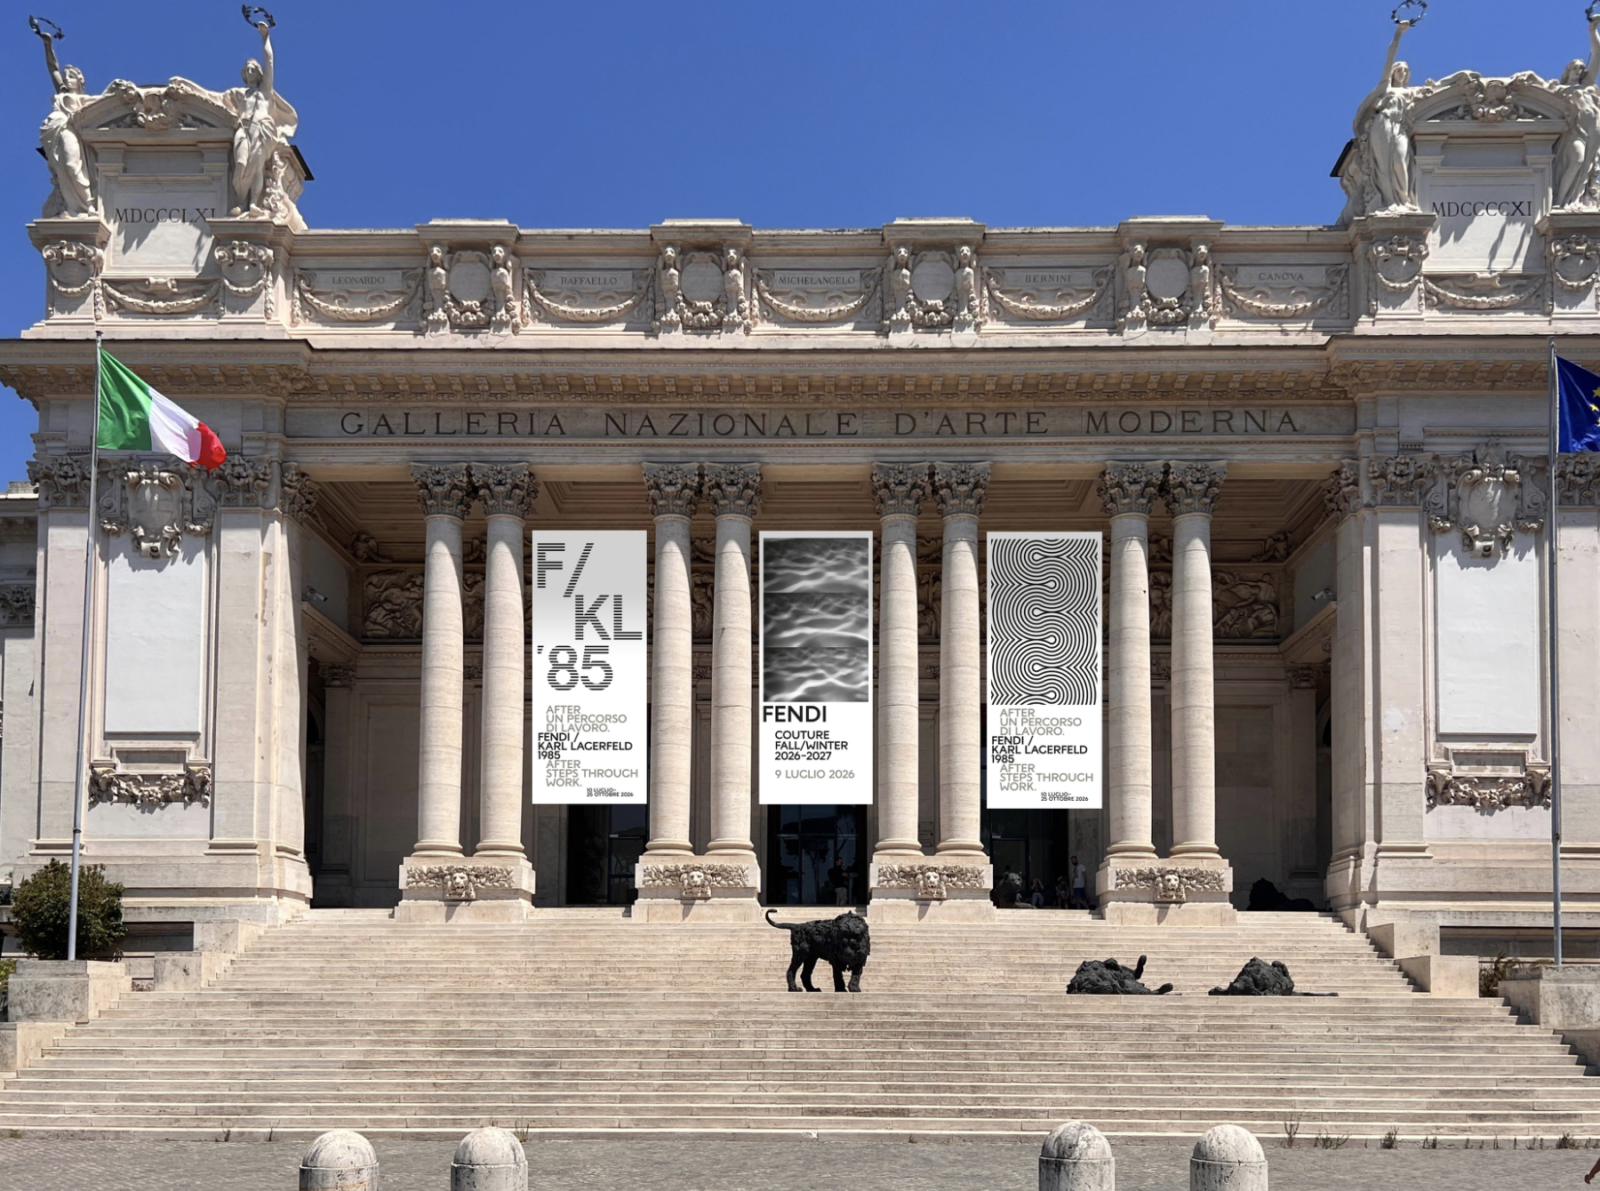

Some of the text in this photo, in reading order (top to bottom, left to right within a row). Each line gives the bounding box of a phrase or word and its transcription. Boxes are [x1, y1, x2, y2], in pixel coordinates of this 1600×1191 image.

[1432, 201, 1533, 217] MDCCCCXI
[332, 276, 385, 285] LEONARDO
[561, 276, 617, 285] RAFFAELLO
[779, 276, 856, 285] MICHELANGELO
[1025, 274, 1071, 283] BERNINI
[1258, 272, 1304, 281] CANOVA
[340, 410, 1300, 436] GALLERIA NAZIONALE D'ARTE MODERNA
[537, 543, 594, 597] F/
[575, 595, 642, 640] KL
[546, 705, 581, 714] AFTER
[763, 705, 826, 722] FENDI
[1000, 708, 1035, 717] AFTER
[546, 714, 627, 723] UN PERCORSO
[1000, 717, 1082, 727] UN PERCORSO
[546, 723, 610, 732] DI LAVORO.
[1000, 726, 1065, 735] DI LAVORO.
[538, 732, 570, 741] FENDI
[775, 730, 830, 739] COUTURE
[991, 736, 1024, 745] FENDI
[538, 741, 633, 750] KARL LAGERFELD
[775, 740, 848, 751] FALL/WINTER
[991, 745, 1088, 754] KARL LAGERFELD
[537, 750, 561, 759] 1985
[775, 751, 832, 760] 2026-2027
[991, 754, 1015, 763] 1985
[546, 760, 581, 768] AFTER
[1000, 763, 1035, 772] AFTER
[546, 769, 638, 778] STEPS THROUGH
[775, 769, 855, 779] 9 LUGLIO 2026
[1000, 772, 1094, 782] STEPS THROUGH
[546, 778, 582, 787] WORK.
[1000, 782, 1037, 791] WORK.
